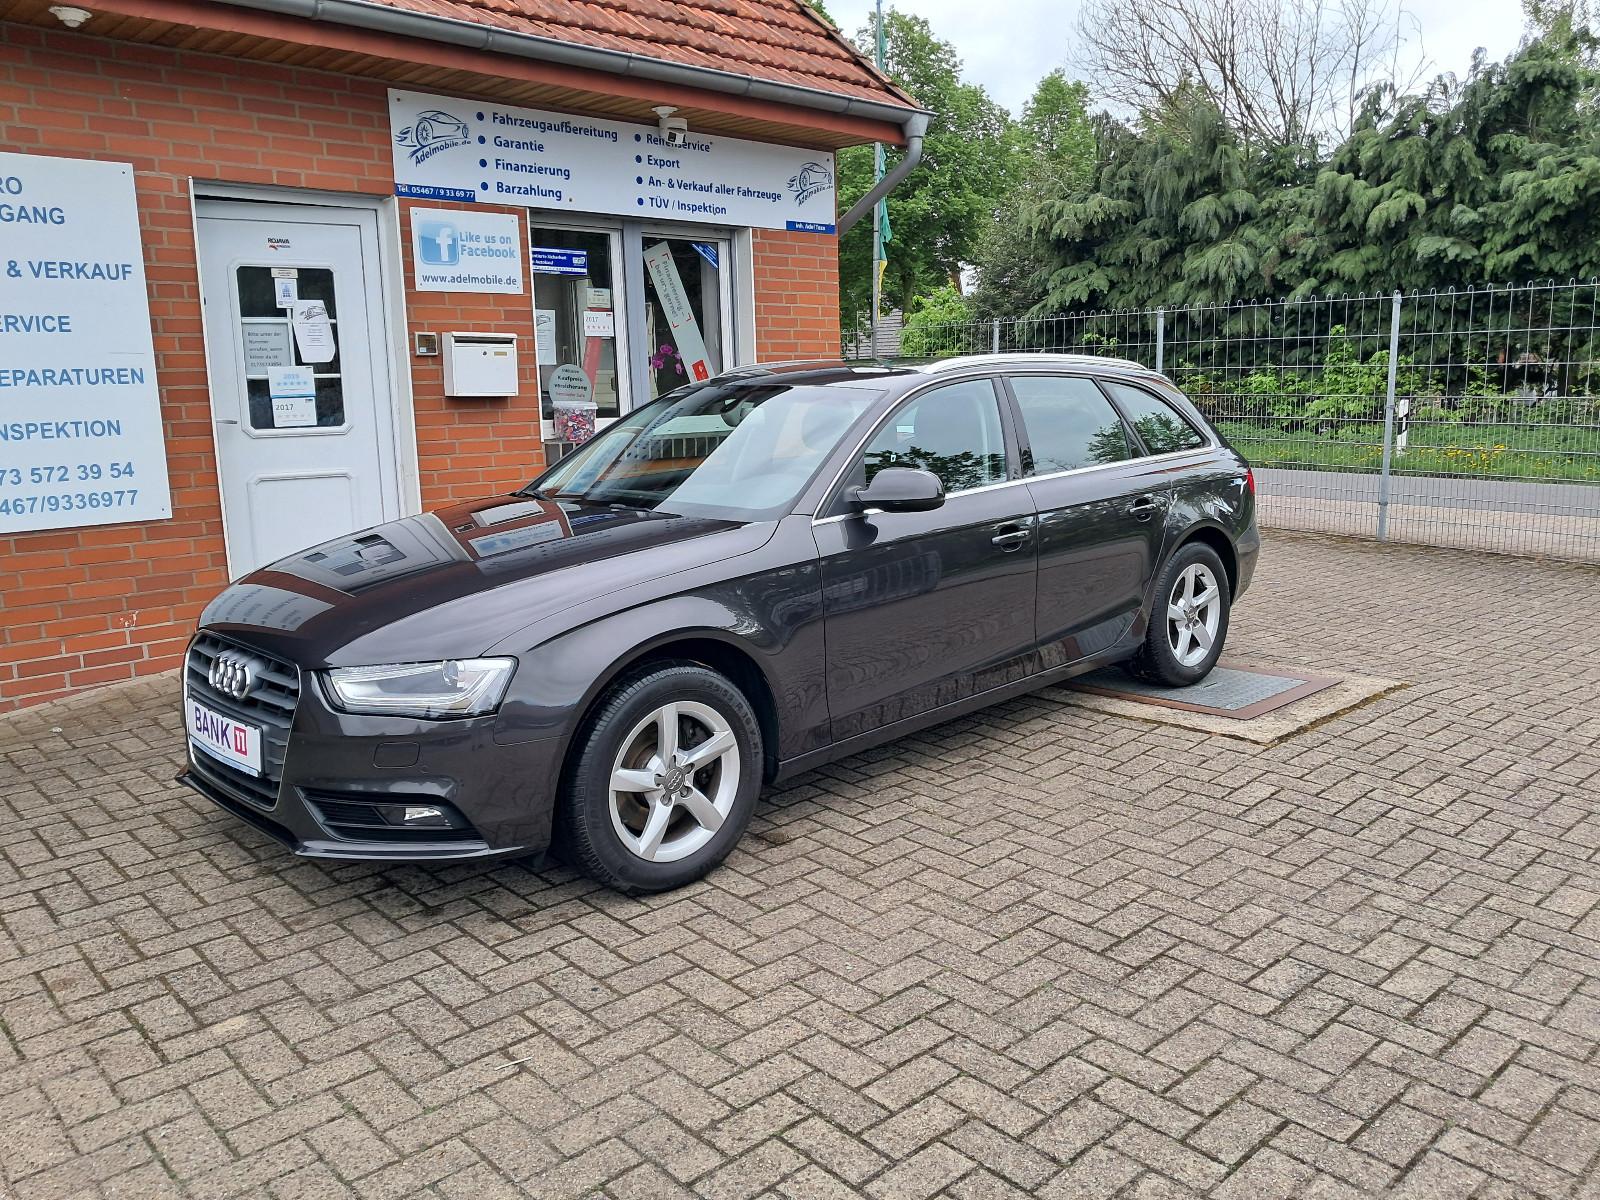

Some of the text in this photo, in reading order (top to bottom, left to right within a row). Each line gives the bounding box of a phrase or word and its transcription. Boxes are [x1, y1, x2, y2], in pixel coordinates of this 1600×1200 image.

[492, 112, 618, 142] Fahrzeugaufbereitung
[494, 136, 545, 152] Garantie
[415, 140, 472, 168] Adelmobile.de
[647, 155, 680, 169] Export
[495, 158, 571, 180] Finanzierung
[0, 176, 23, 195] O
[411, 186, 434, 195] 05467
[439, 188, 445, 196] 9
[455, 190, 465, 198] 69
[496, 182, 562, 201] Barzahlung
[648, 176, 782, 203] An- & Verkauf aller Fahrzeuge
[0, 204, 65, 225] GANG
[649, 195, 727, 216] TÜV / Inspektion
[460, 231, 512, 245] Like us on
[460, 245, 516, 259] Facebook
[6, 260, 133, 280] & VERKAUF
[421, 274, 517, 286] www.adelmobile.de
[0, 314, 72, 333] RVICE
[0, 368, 145, 387] EPARATUREN
[30, 466, 69, 484] 572
[77, 463, 102, 481] 39
[109, 462, 135, 478] 54
[0, 490, 139, 515] 467/9336977
[195, 706, 232, 750] BANK
